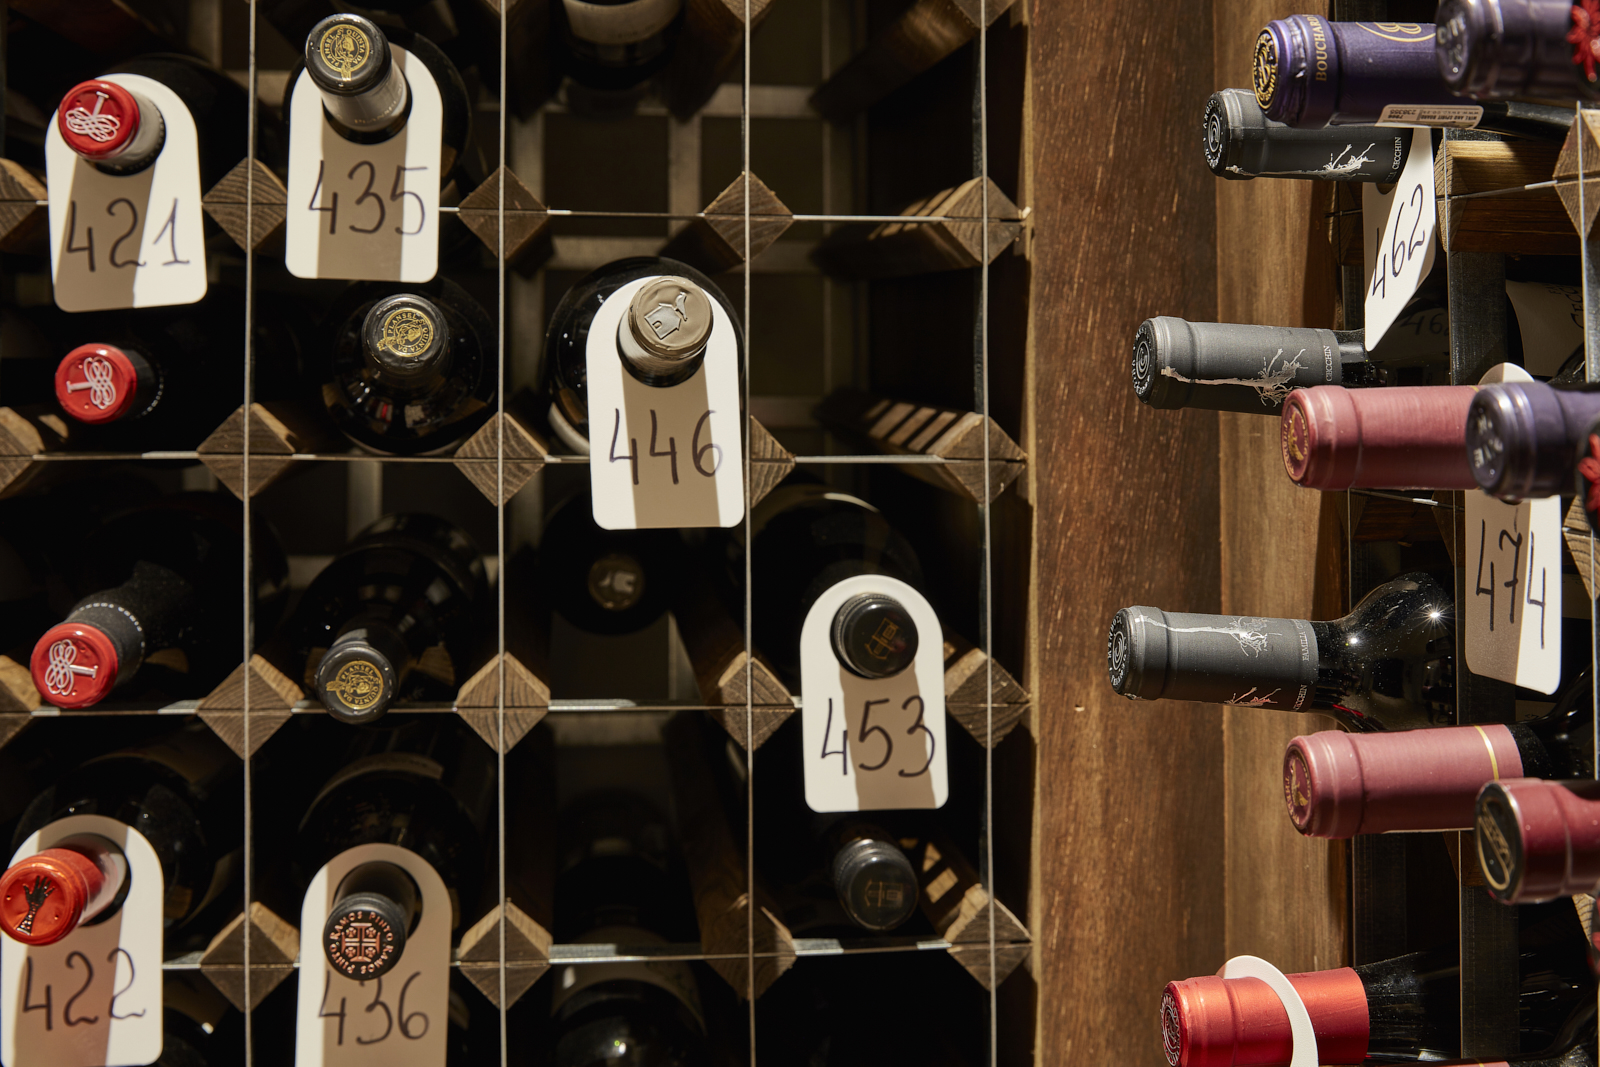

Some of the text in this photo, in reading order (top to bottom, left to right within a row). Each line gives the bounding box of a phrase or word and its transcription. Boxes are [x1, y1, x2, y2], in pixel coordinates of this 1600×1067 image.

[324, 29, 366, 67] QUINTA DA PLANSEL
[1307, 16, 1328, 81] BOUCHARD
[1391, 136, 1402, 170] CECCHIN
[308, 159, 428, 236] 435
[65, 198, 190, 272] 421
[1371, 183, 1426, 300] 462
[387, 312, 429, 353] QUINTA DA PLANSEL
[1323, 345, 1333, 382] CECCHIN
[609, 407, 723, 485] 446
[1475, 510, 1546, 649] 474
[341, 665, 374, 680] PLANSEL
[1299, 631, 1310, 662] FAMILIA
[354, 686, 379, 705] QUINTA
[821, 695, 936, 778] 453
[329, 911, 394, 941] RAMOS PINTO
[329, 943, 394, 974] RAMOS PINTO
[22, 947, 146, 1031] 422
[317, 969, 430, 1046] 436
